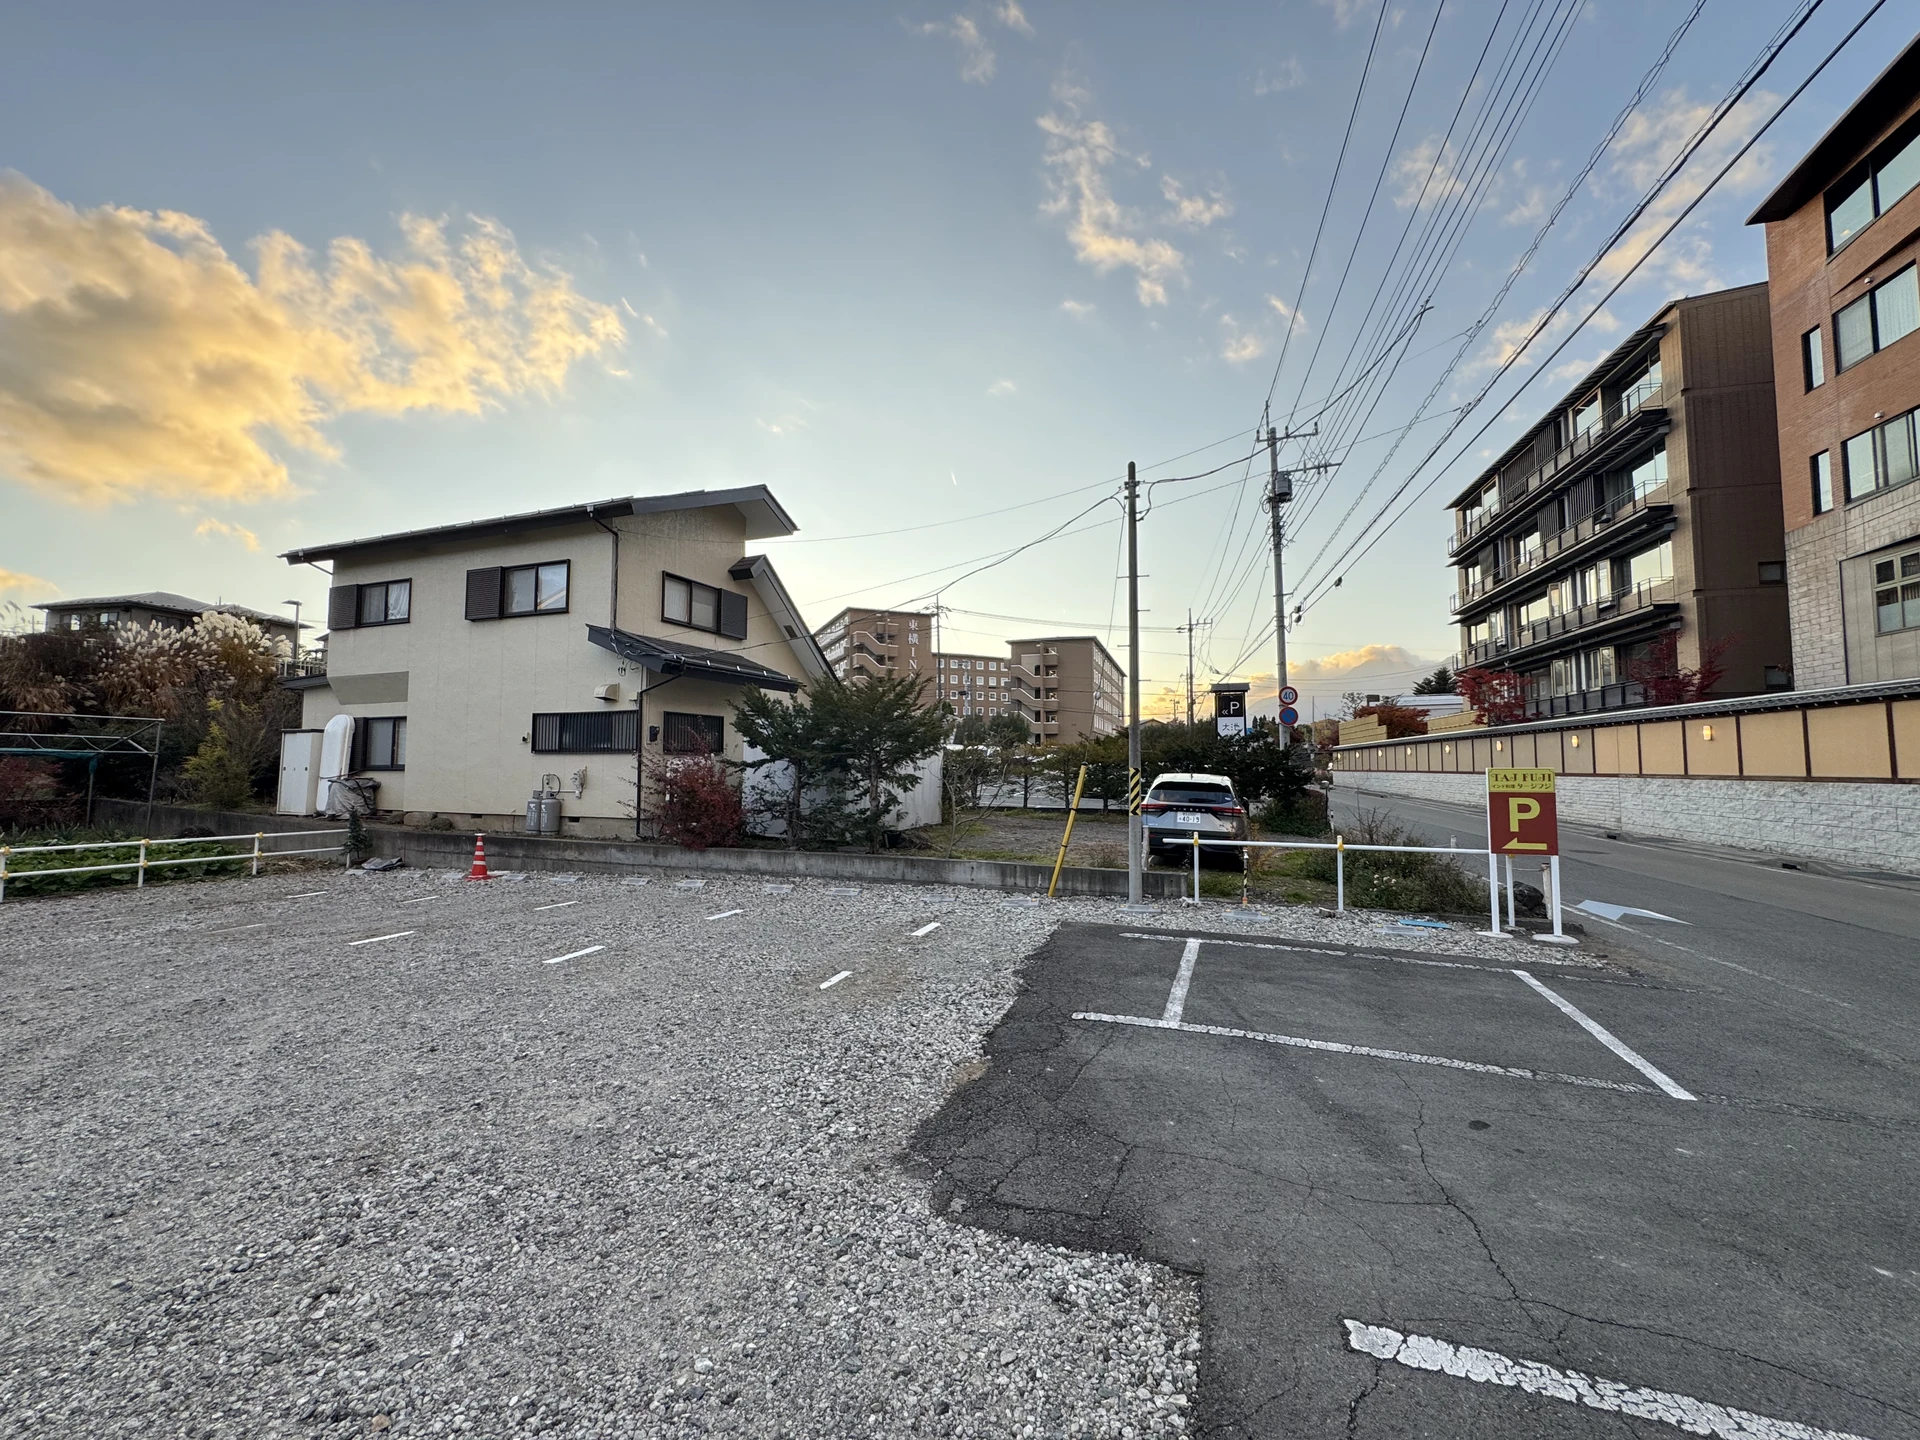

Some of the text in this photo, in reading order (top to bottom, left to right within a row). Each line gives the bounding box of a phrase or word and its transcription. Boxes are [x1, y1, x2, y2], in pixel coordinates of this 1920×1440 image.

[1283, 691, 1294, 701] 40
[1230, 701, 1240, 714] P
[1490, 773, 1552, 782] TAJ FUJI
[1508, 797, 1541, 832] P
